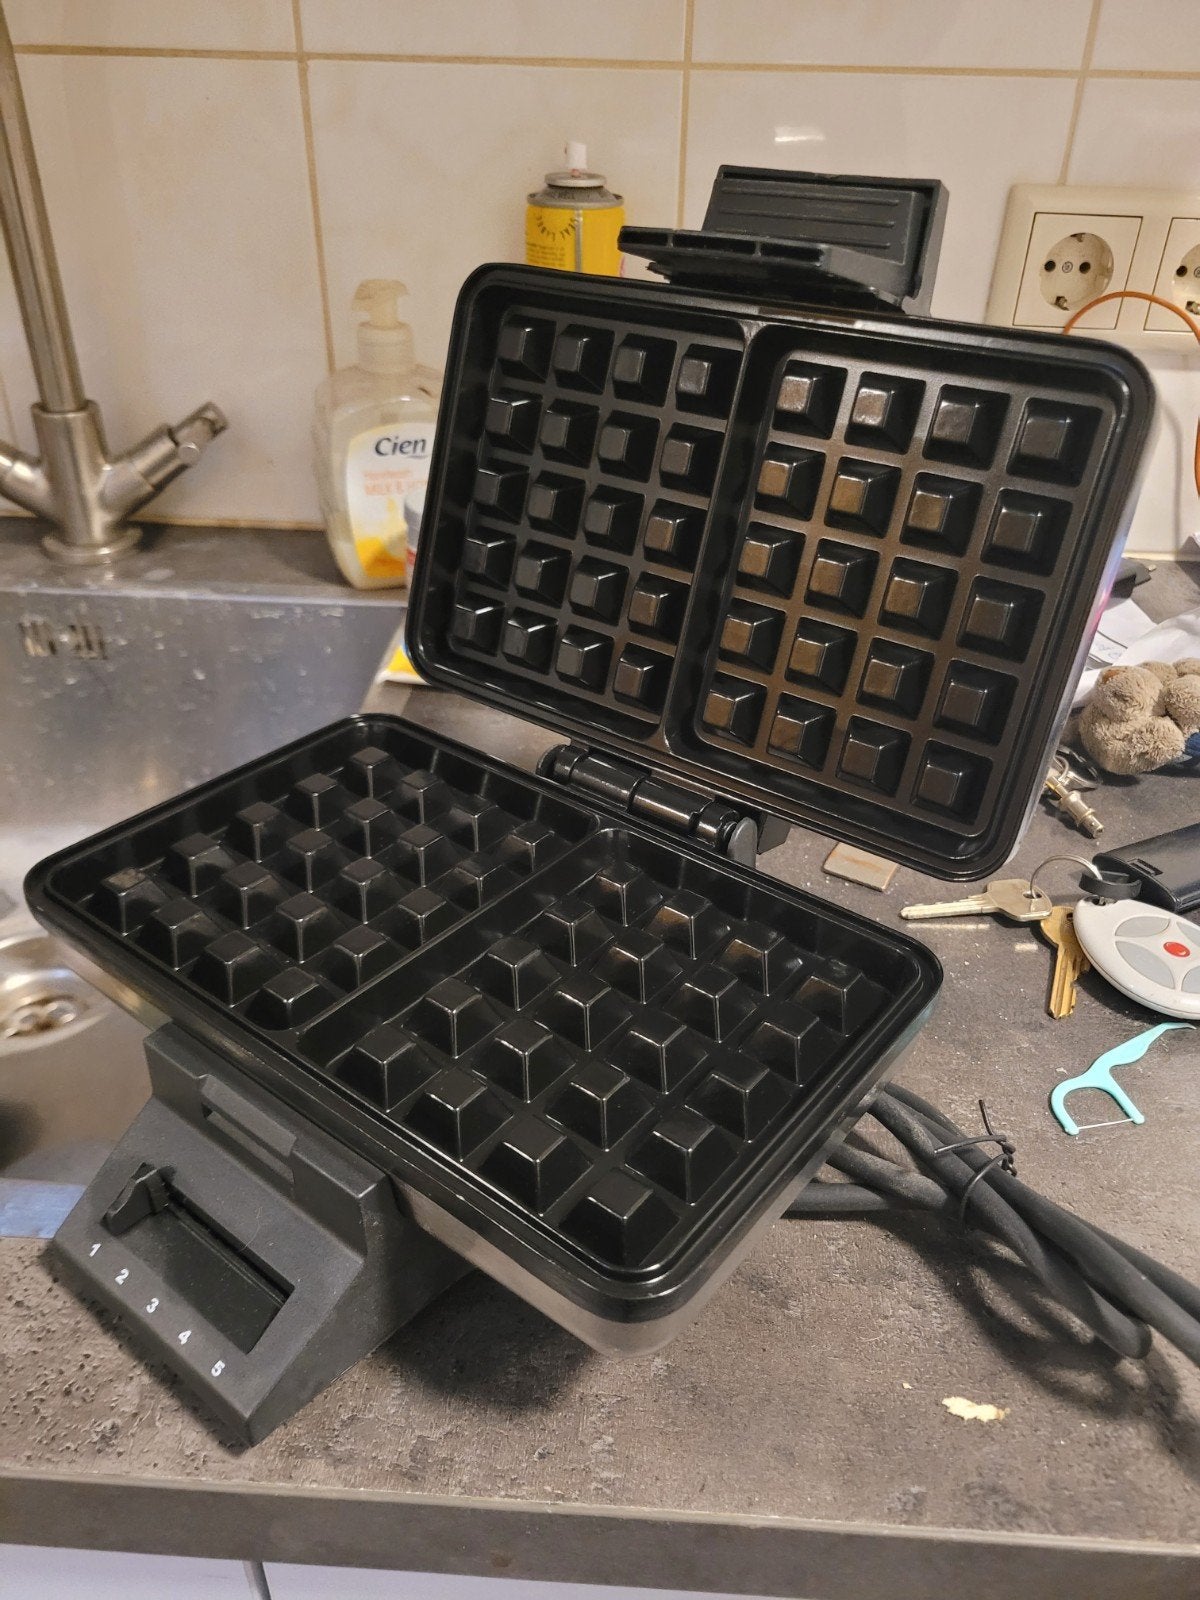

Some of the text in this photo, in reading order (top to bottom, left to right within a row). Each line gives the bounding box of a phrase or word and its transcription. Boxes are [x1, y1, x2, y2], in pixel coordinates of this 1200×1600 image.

[374, 435, 427, 457] Cien
[89, 1243, 225, 1377] 1 2 3 4 5
